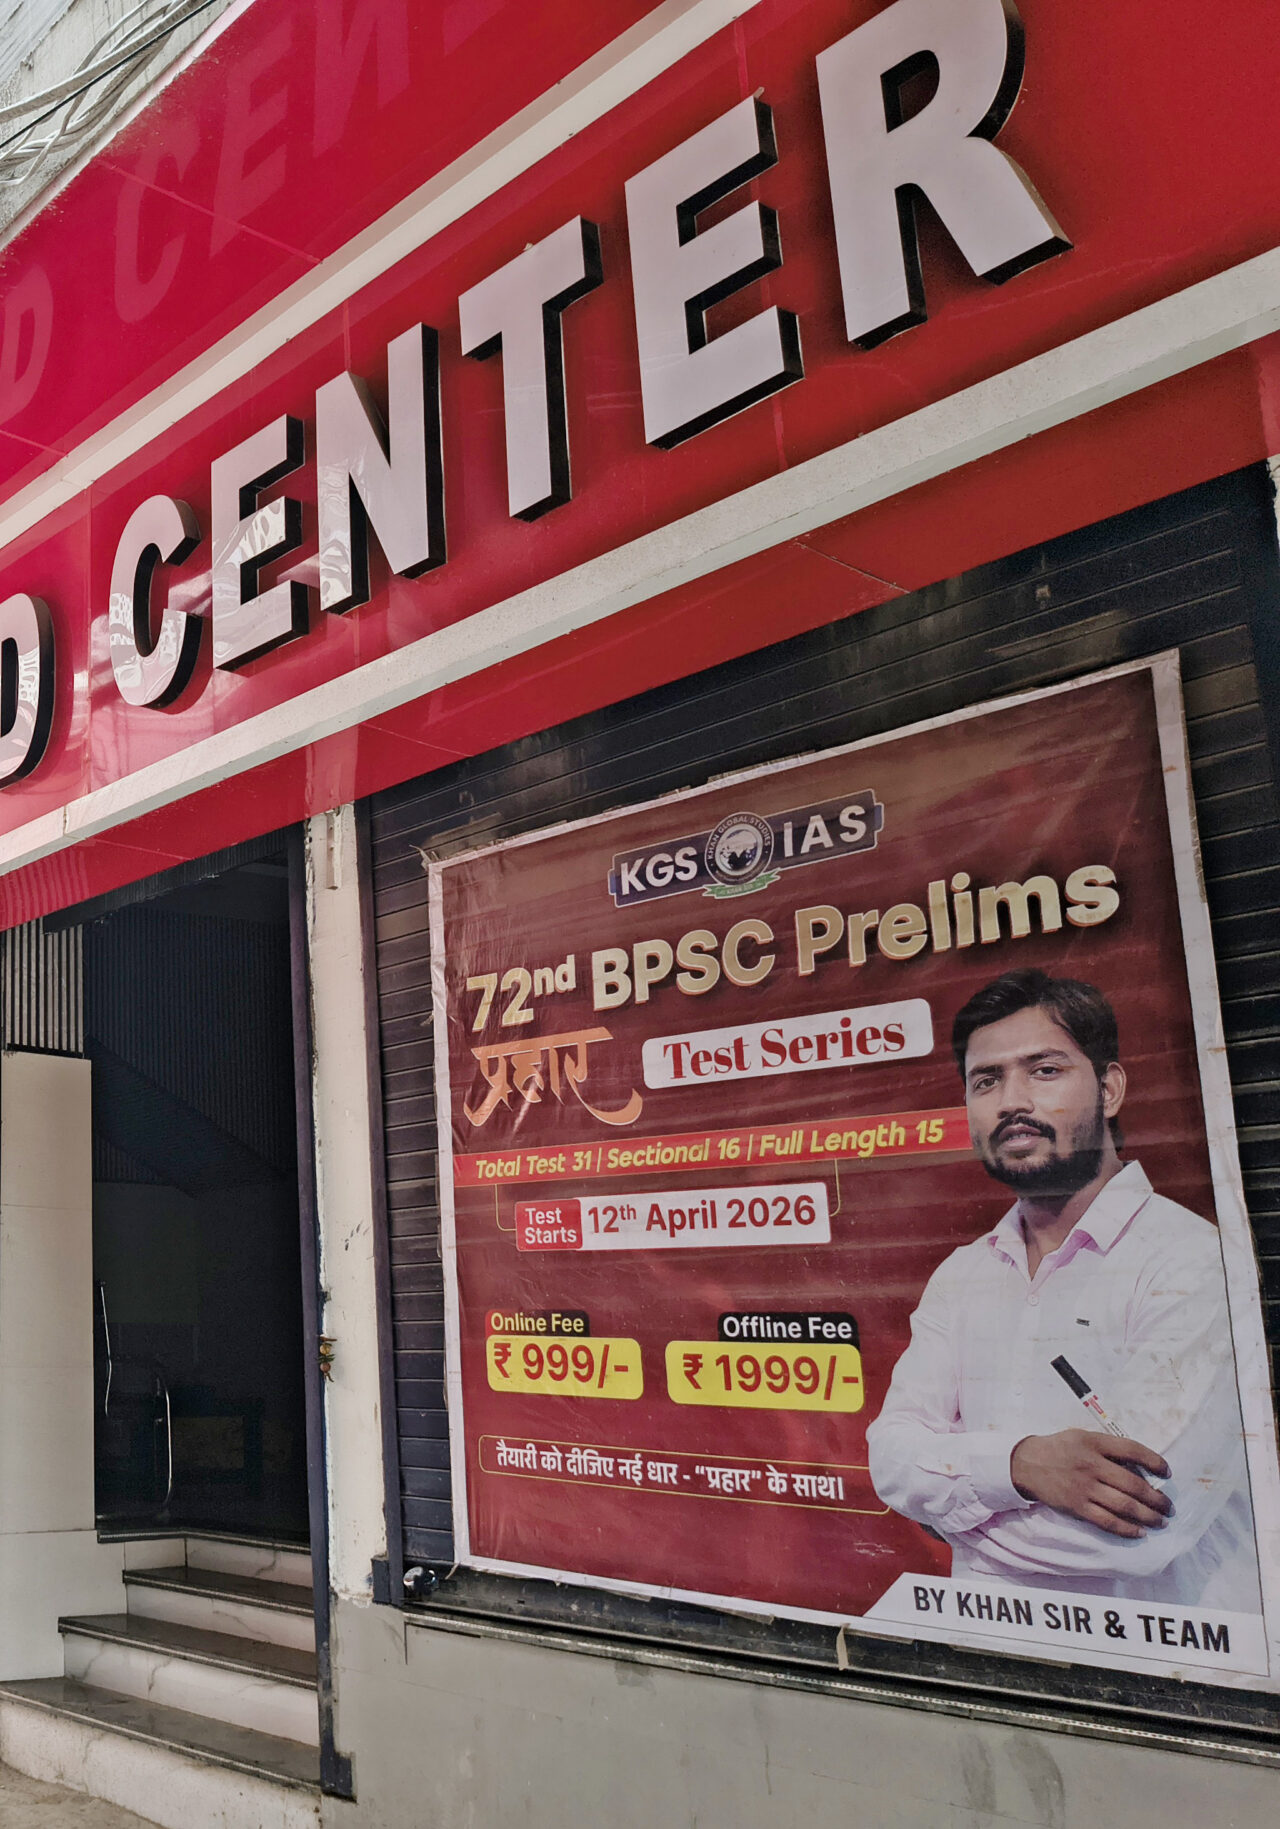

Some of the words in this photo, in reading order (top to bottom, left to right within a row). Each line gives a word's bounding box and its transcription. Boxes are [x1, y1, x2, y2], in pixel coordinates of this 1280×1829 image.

[109, 0, 1074, 709] CENTER
[620, 845, 700, 897] KGS
[783, 804, 868, 858] IAS
[708, 834, 720, 860] KHAN
[718, 816, 747, 834] GLOBAL
[750, 816, 771, 847] STUDIES
[466, 954, 577, 1033] 72nd
[592, 918, 776, 1013] BPSC
[795, 864, 1121, 977] Prelims
[663, 1033, 752, 1081] Test
[760, 1017, 906, 1068] Series
[464, 1026, 643, 1127] प्रहार
[476, 1156, 521, 1180] Total
[526, 1154, 566, 1175] Test
[573, 1151, 592, 1172] 31
[607, 1138, 710, 1169] Sectional
[717, 1139, 741, 1160] 16
[758, 1132, 805, 1158] Full
[809, 1125, 906, 1159] Length
[915, 1118, 944, 1145] 15
[525, 1207, 562, 1225] Test
[525, 1226, 577, 1246] Starts
[588, 1204, 637, 1234] 12th
[645, 1199, 718, 1238] April
[727, 1194, 816, 1229] 2026
[491, 1311, 547, 1333] Online
[551, 1313, 584, 1334] Fee
[723, 1316, 804, 1338] Offline
[809, 1318, 853, 1340] Fee
[523, 1343, 629, 1388] 999/-
[715, 1354, 859, 1401] 1999/-
[496, 1439, 537, 1470] तैयारी
[540, 1444, 563, 1473] को
[566, 1447, 613, 1479] दीजिए
[618, 1451, 643, 1486] नई
[648, 1461, 678, 1485] धार
[767, 1464, 788, 1496] के
[914, 1586, 945, 1614] BY
[957, 1591, 1033, 1626] KHAN
[1045, 1603, 1093, 1634] SIR
[1105, 1610, 1127, 1640] &
[1137, 1614, 1231, 1654] TEAM
